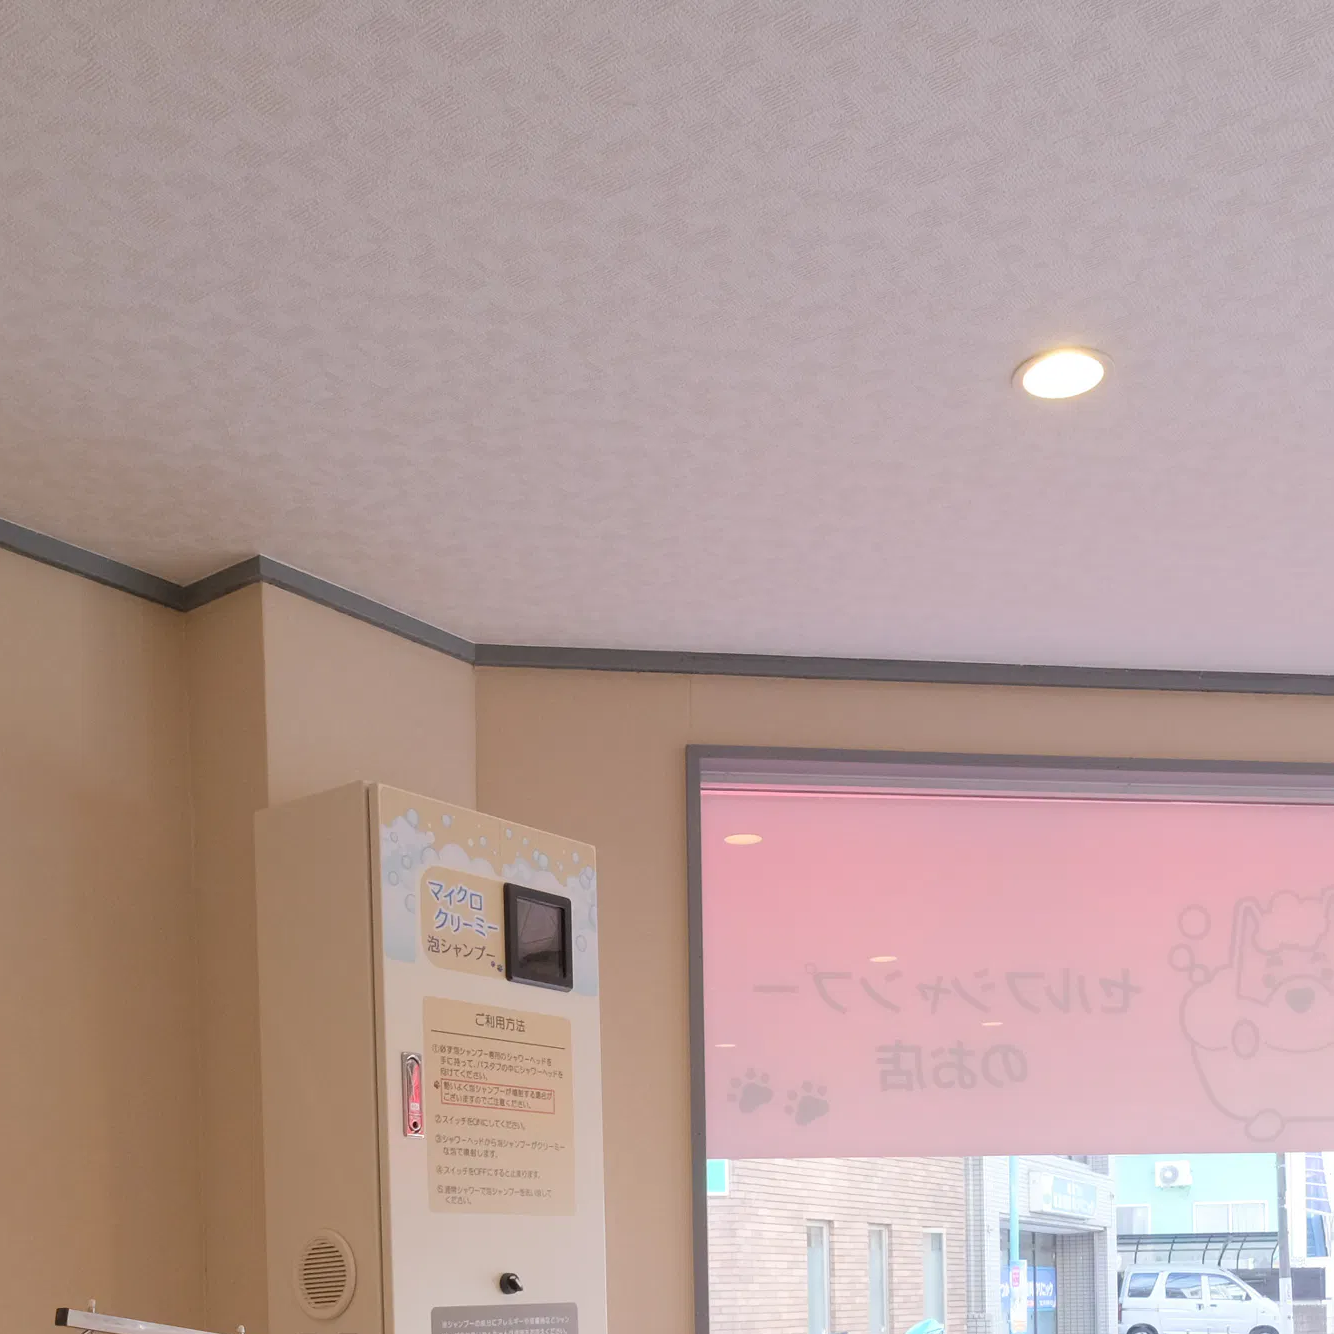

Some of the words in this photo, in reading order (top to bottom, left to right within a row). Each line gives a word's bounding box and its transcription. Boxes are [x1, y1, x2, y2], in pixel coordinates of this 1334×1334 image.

[427, 880, 483, 912] マイクロ
[435, 907, 499, 937] クリーミー
[427, 935, 496, 960] 泡シャンプー
[475, 1012, 526, 1033] ご利用方法
